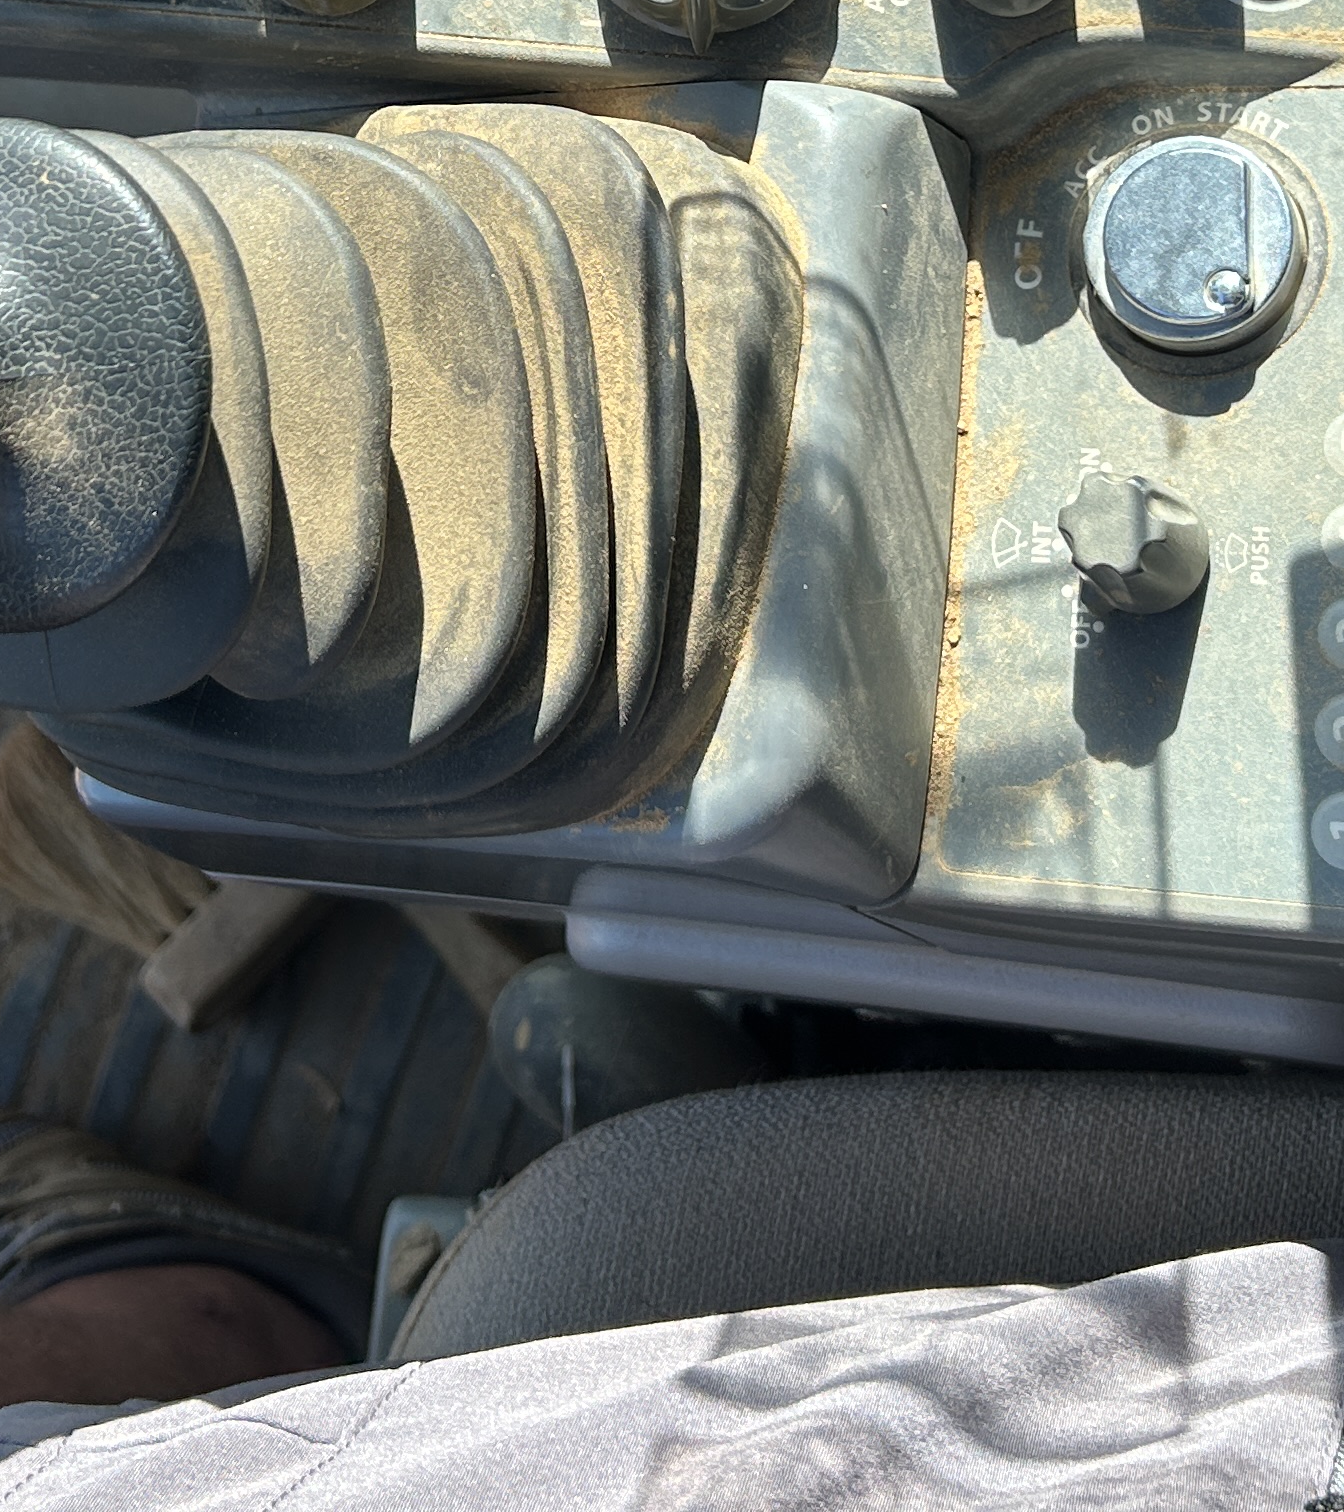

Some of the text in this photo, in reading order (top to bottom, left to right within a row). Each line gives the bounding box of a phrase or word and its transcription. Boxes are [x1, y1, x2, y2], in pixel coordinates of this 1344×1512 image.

[1131, 105, 1175, 136] ON
[1197, 101, 1290, 139] START
[1063, 145, 1107, 199] ACC
[1030, 521, 1053, 564] INT
[1249, 526, 1272, 585] PUSH
